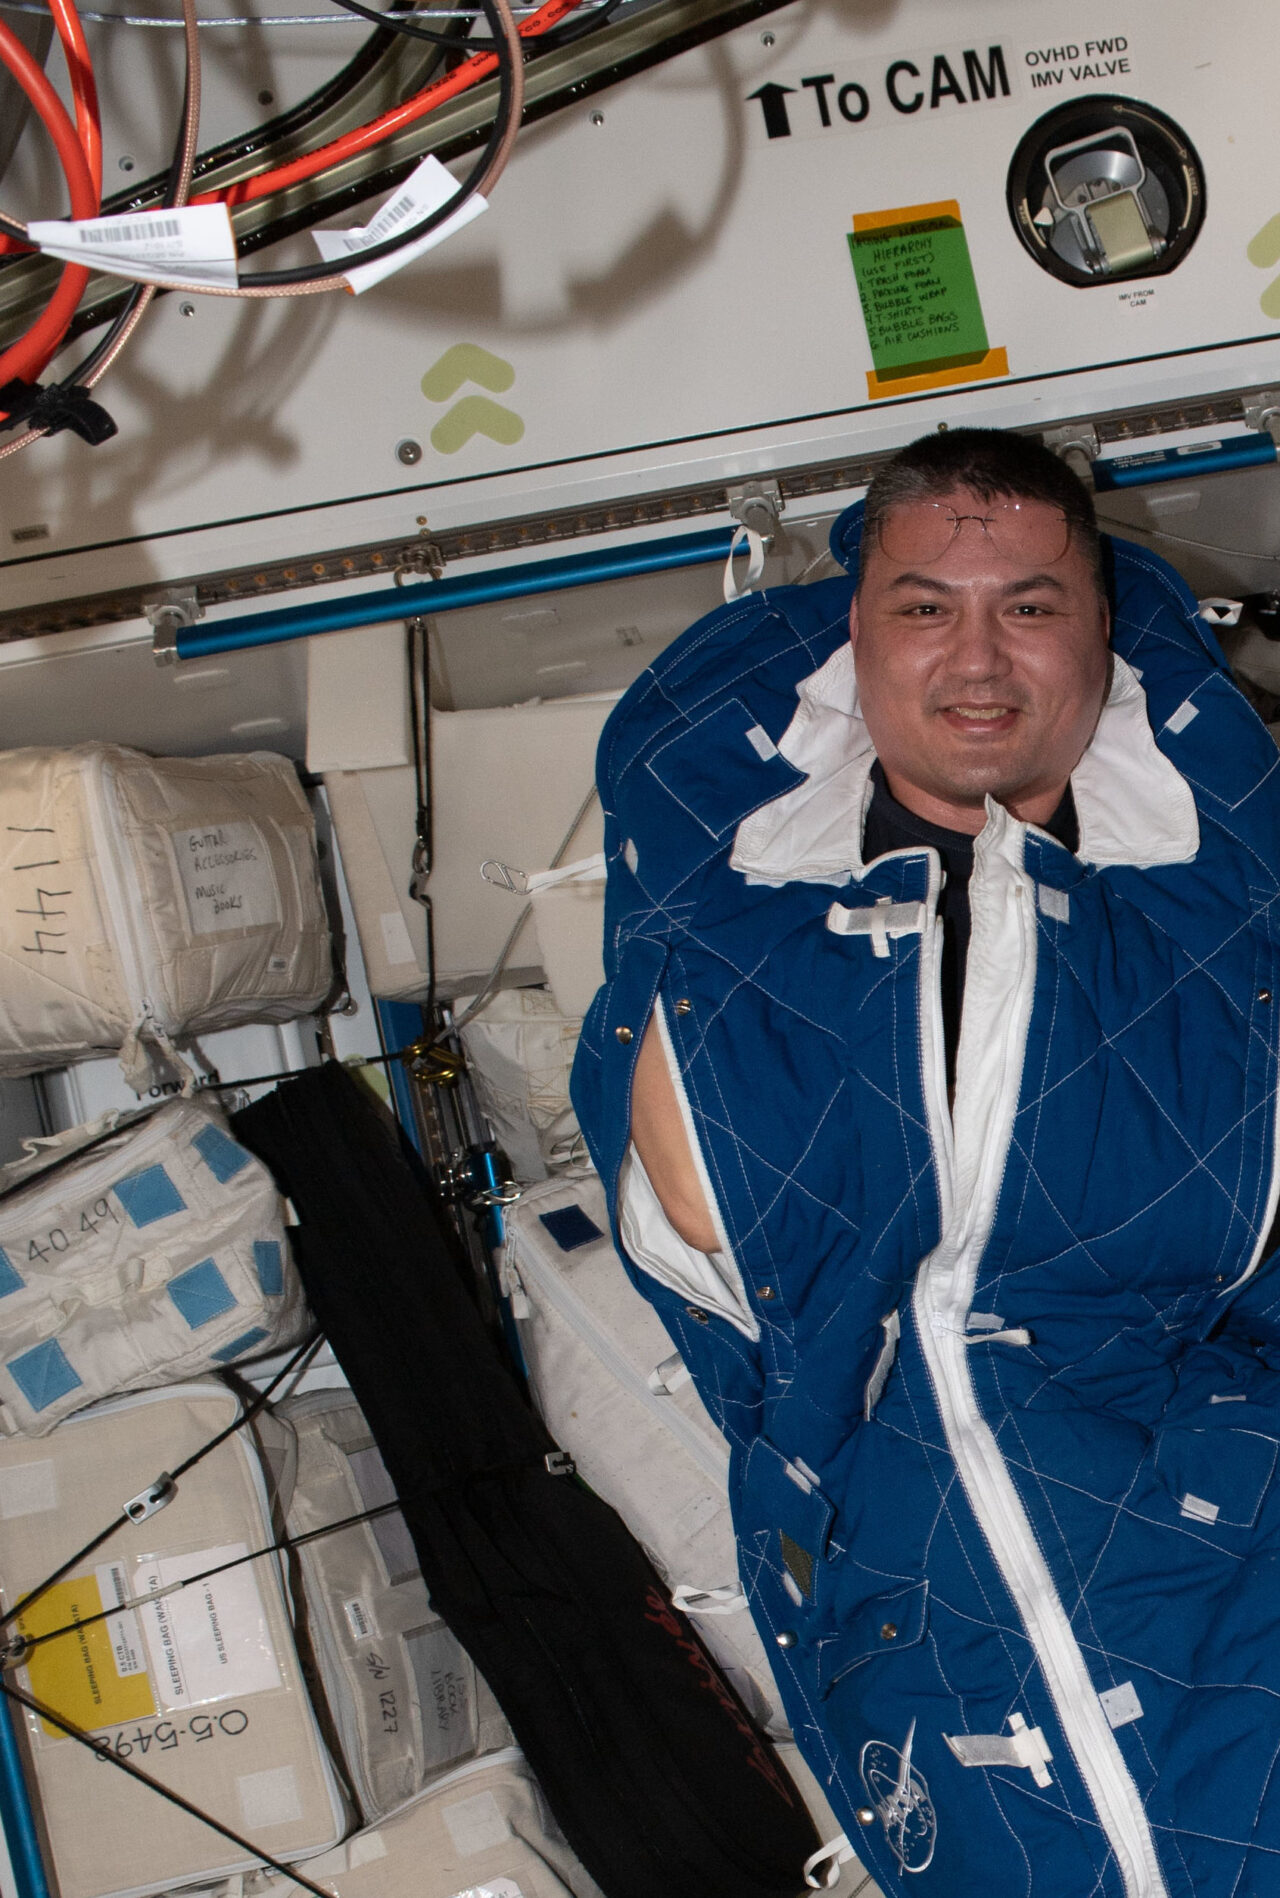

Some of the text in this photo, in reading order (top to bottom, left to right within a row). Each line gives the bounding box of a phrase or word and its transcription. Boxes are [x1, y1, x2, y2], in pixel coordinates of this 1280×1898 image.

[1025, 36, 1128, 67] OVHD FWD
[1031, 58, 1131, 88] IMV VALVE
[801, 45, 1011, 127] To CAM
[873, 237, 933, 263] HIERARCHY
[874, 295, 912, 313] BUBBLE
[1118, 288, 1155, 301] IMV FROM
[1130, 299, 1147, 307] CAM
[878, 318, 925, 336] BUBBLE
[928, 311, 959, 326] BAGS
[884, 333, 903, 346] AIR
[907, 322, 960, 342] CUSHIONS
[204, 1593, 216, 1612] BAG
[148, 1575, 184, 1696] SLEEPING BAG (WAKTA)
[209, 1613, 225, 1655] SLEEPING
[81, 1645, 91, 1664] BAG
[218, 1654, 228, 1665] US
[87, 1664, 102, 1705] SLEEPING
[365, 1652, 399, 1733] S/N 1227
